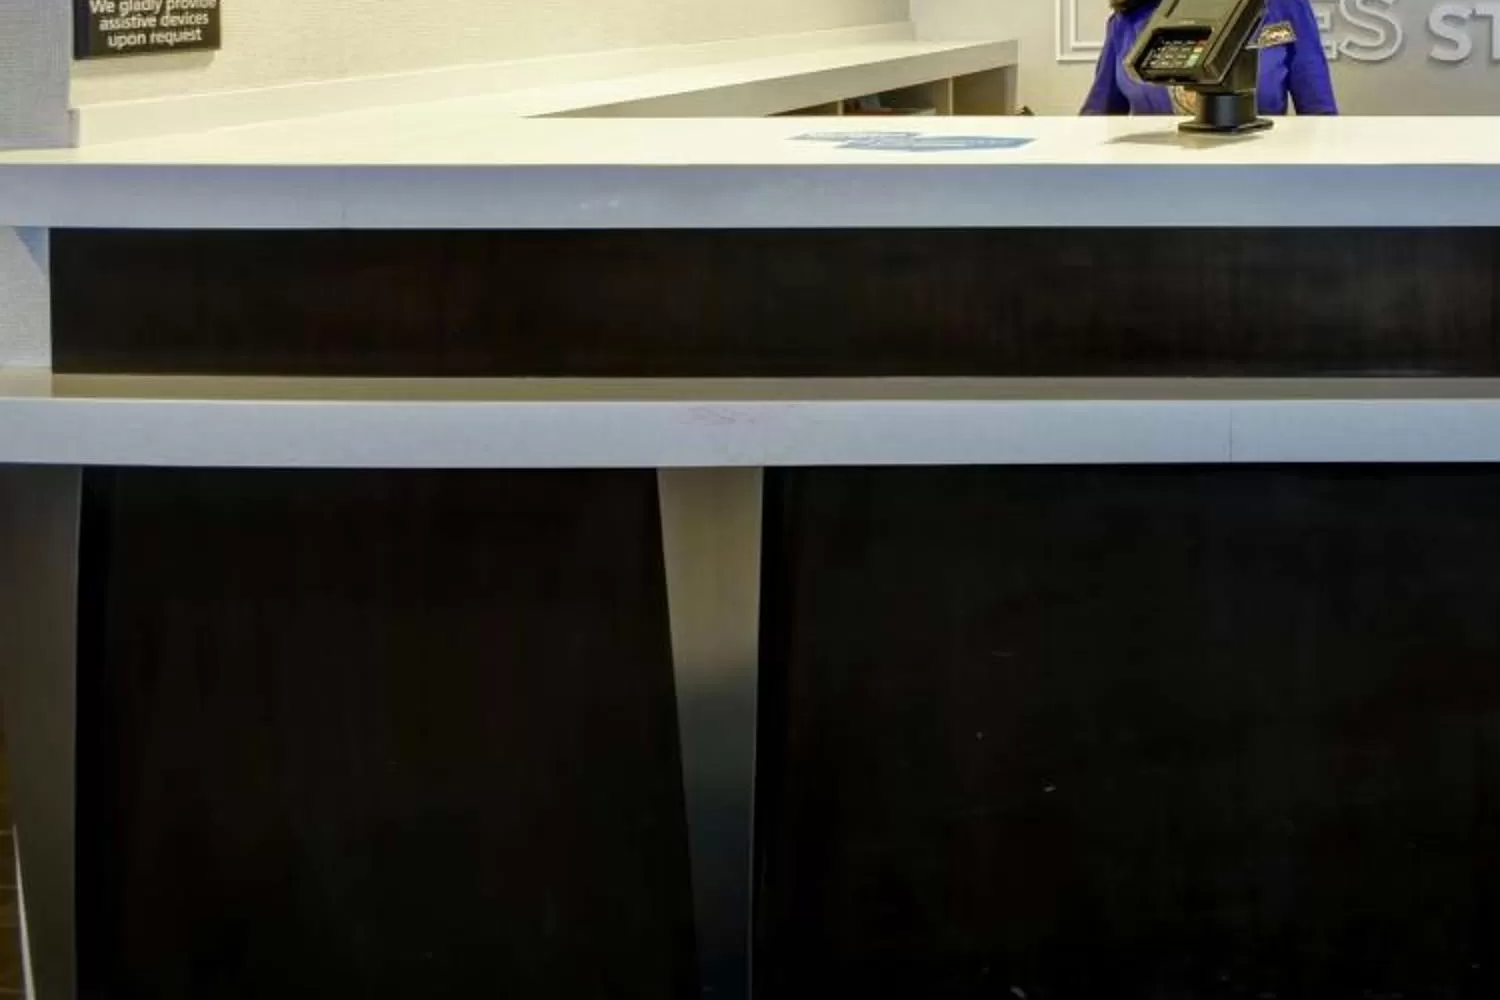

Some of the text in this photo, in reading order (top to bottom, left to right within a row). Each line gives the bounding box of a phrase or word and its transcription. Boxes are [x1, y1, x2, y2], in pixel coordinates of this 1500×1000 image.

[99, 12, 209, 31] assistive devices
[107, 29, 203, 49] upon request
